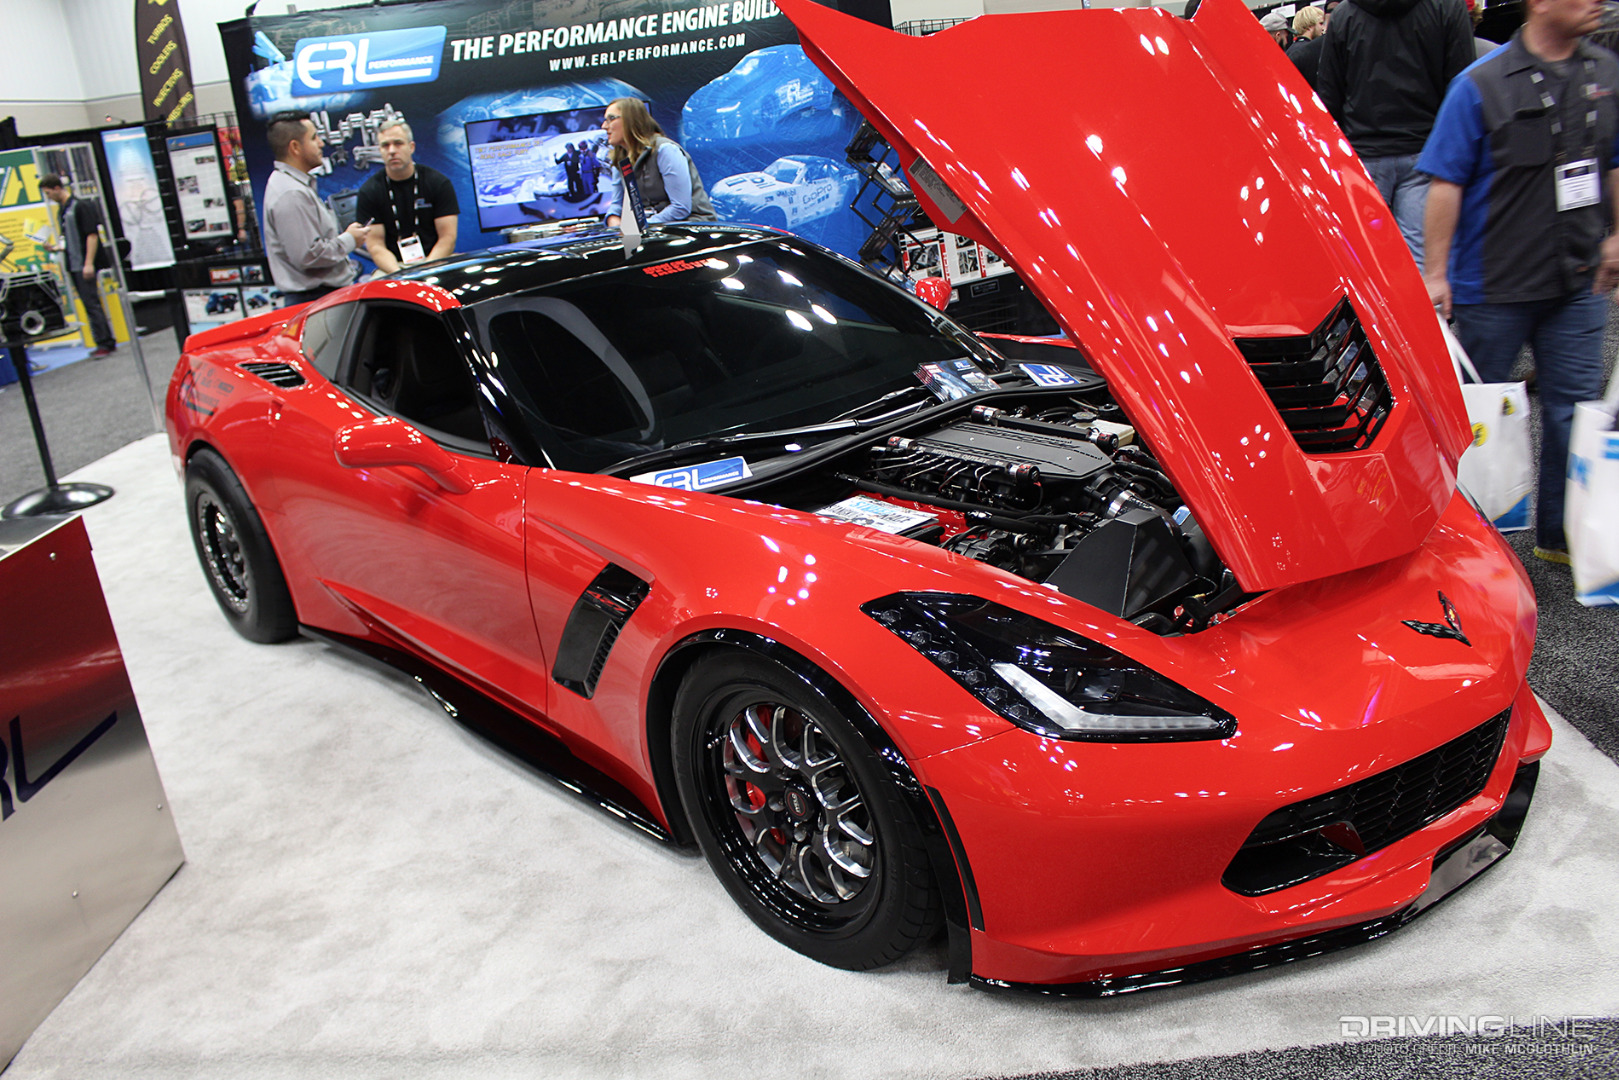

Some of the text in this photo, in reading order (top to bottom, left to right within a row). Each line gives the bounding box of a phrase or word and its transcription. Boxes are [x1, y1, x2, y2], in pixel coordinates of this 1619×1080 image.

[450, 0, 784, 62] THE PERFORMANCE ENGINE BUILD
[549, 33, 746, 72] WWW.ERLPERFORMANCE.COM
[296, 38, 433, 89] ERL
[368, 55, 434, 70] PERFORMANCE
